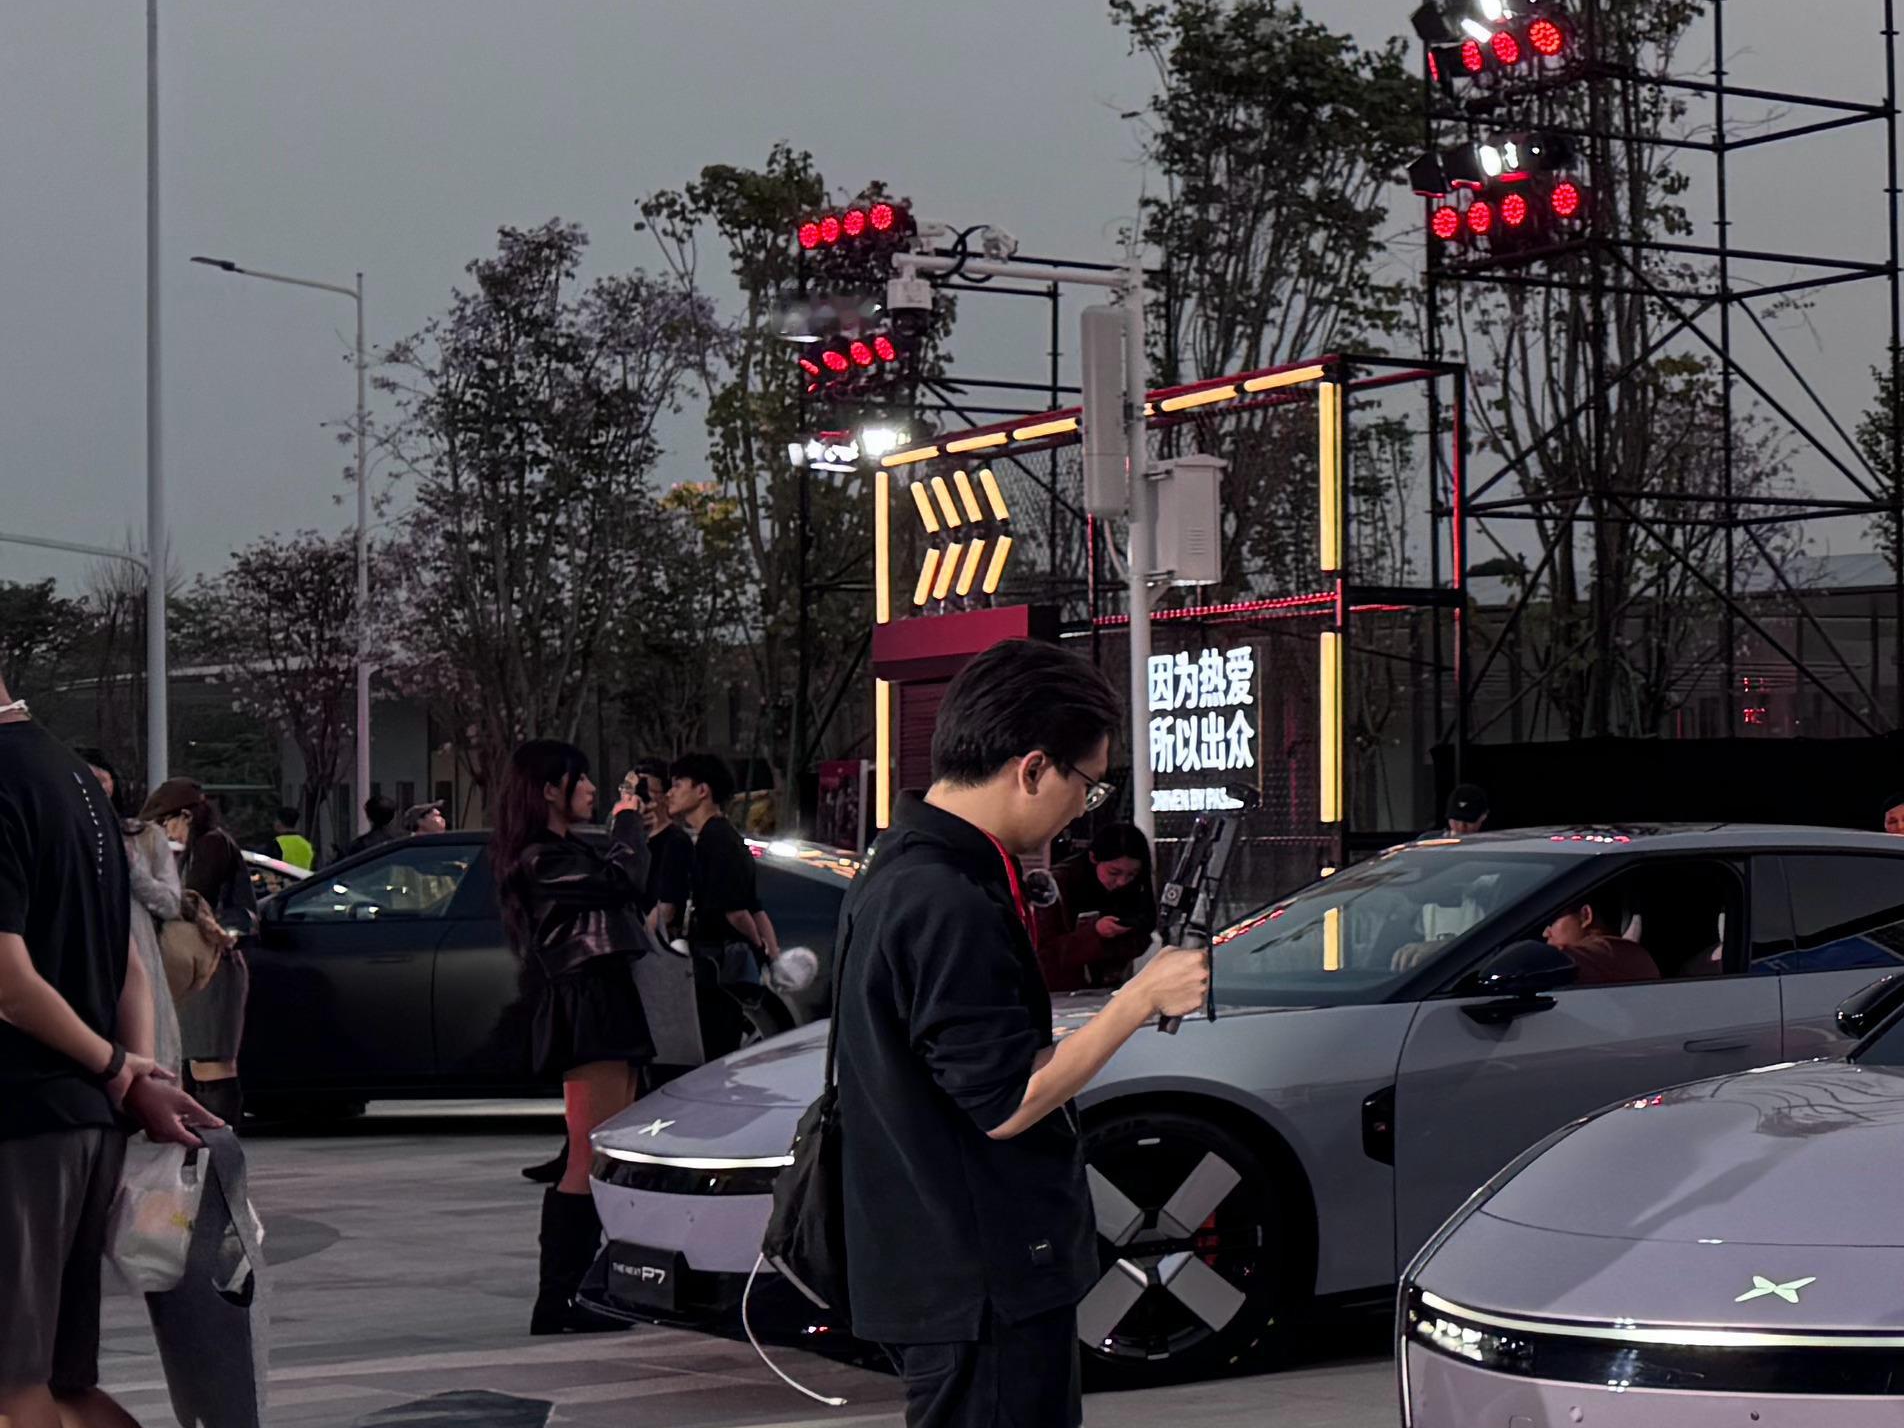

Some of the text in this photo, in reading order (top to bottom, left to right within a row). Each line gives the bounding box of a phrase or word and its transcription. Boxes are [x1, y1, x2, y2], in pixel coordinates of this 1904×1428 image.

[1148, 646, 1254, 711] 因为热爱
[1149, 709, 1255, 773] 所以出众
[641, 1266, 666, 1285] P7
